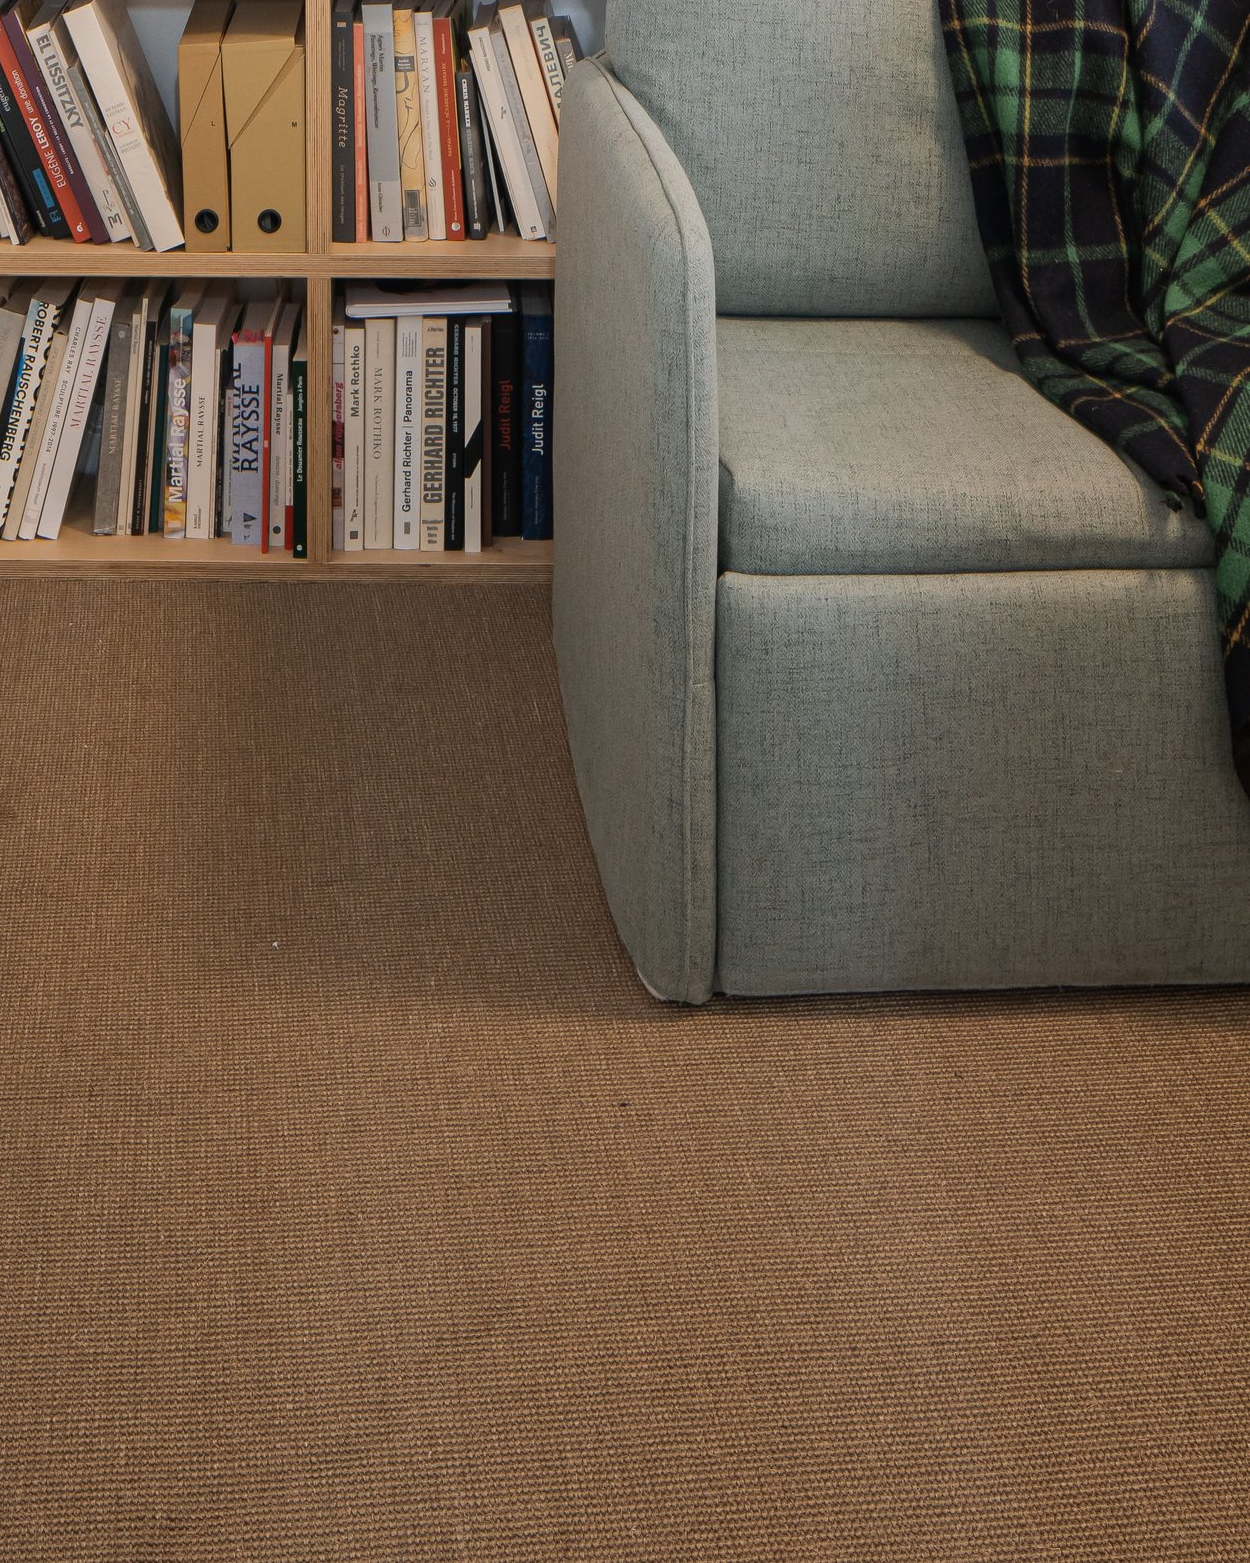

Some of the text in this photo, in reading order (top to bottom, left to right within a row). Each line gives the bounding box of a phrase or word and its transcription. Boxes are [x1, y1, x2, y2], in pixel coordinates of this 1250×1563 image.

[36, 34, 84, 128] EL LISSITZKY
[420, 36, 430, 94] MARYAN
[11, 69, 67, 188] EUGÈNE LEROY une donation
[337, 86, 348, 148] Magritte
[29, 302, 49, 350] ROBERT
[0, 355, 36, 461] RAUSCHENBERG
[69, 316, 107, 428] MARTIAL RAYSSE
[350, 345, 360, 417] Mark Rothko
[373, 368, 382, 460] MARK ROTHKO
[499, 379, 512, 450] Judit Reigl
[168, 378, 190, 503] Martial Raysse
[196, 395, 205, 467] MARTIAL RAYSSE
[240, 384, 259, 473] RAYSSE
[402, 370, 413, 512] Gerhard Richter Panorama
[424, 347, 444, 503] GERHARD RICHTER
[532, 384, 546, 455] Judit Reigl
